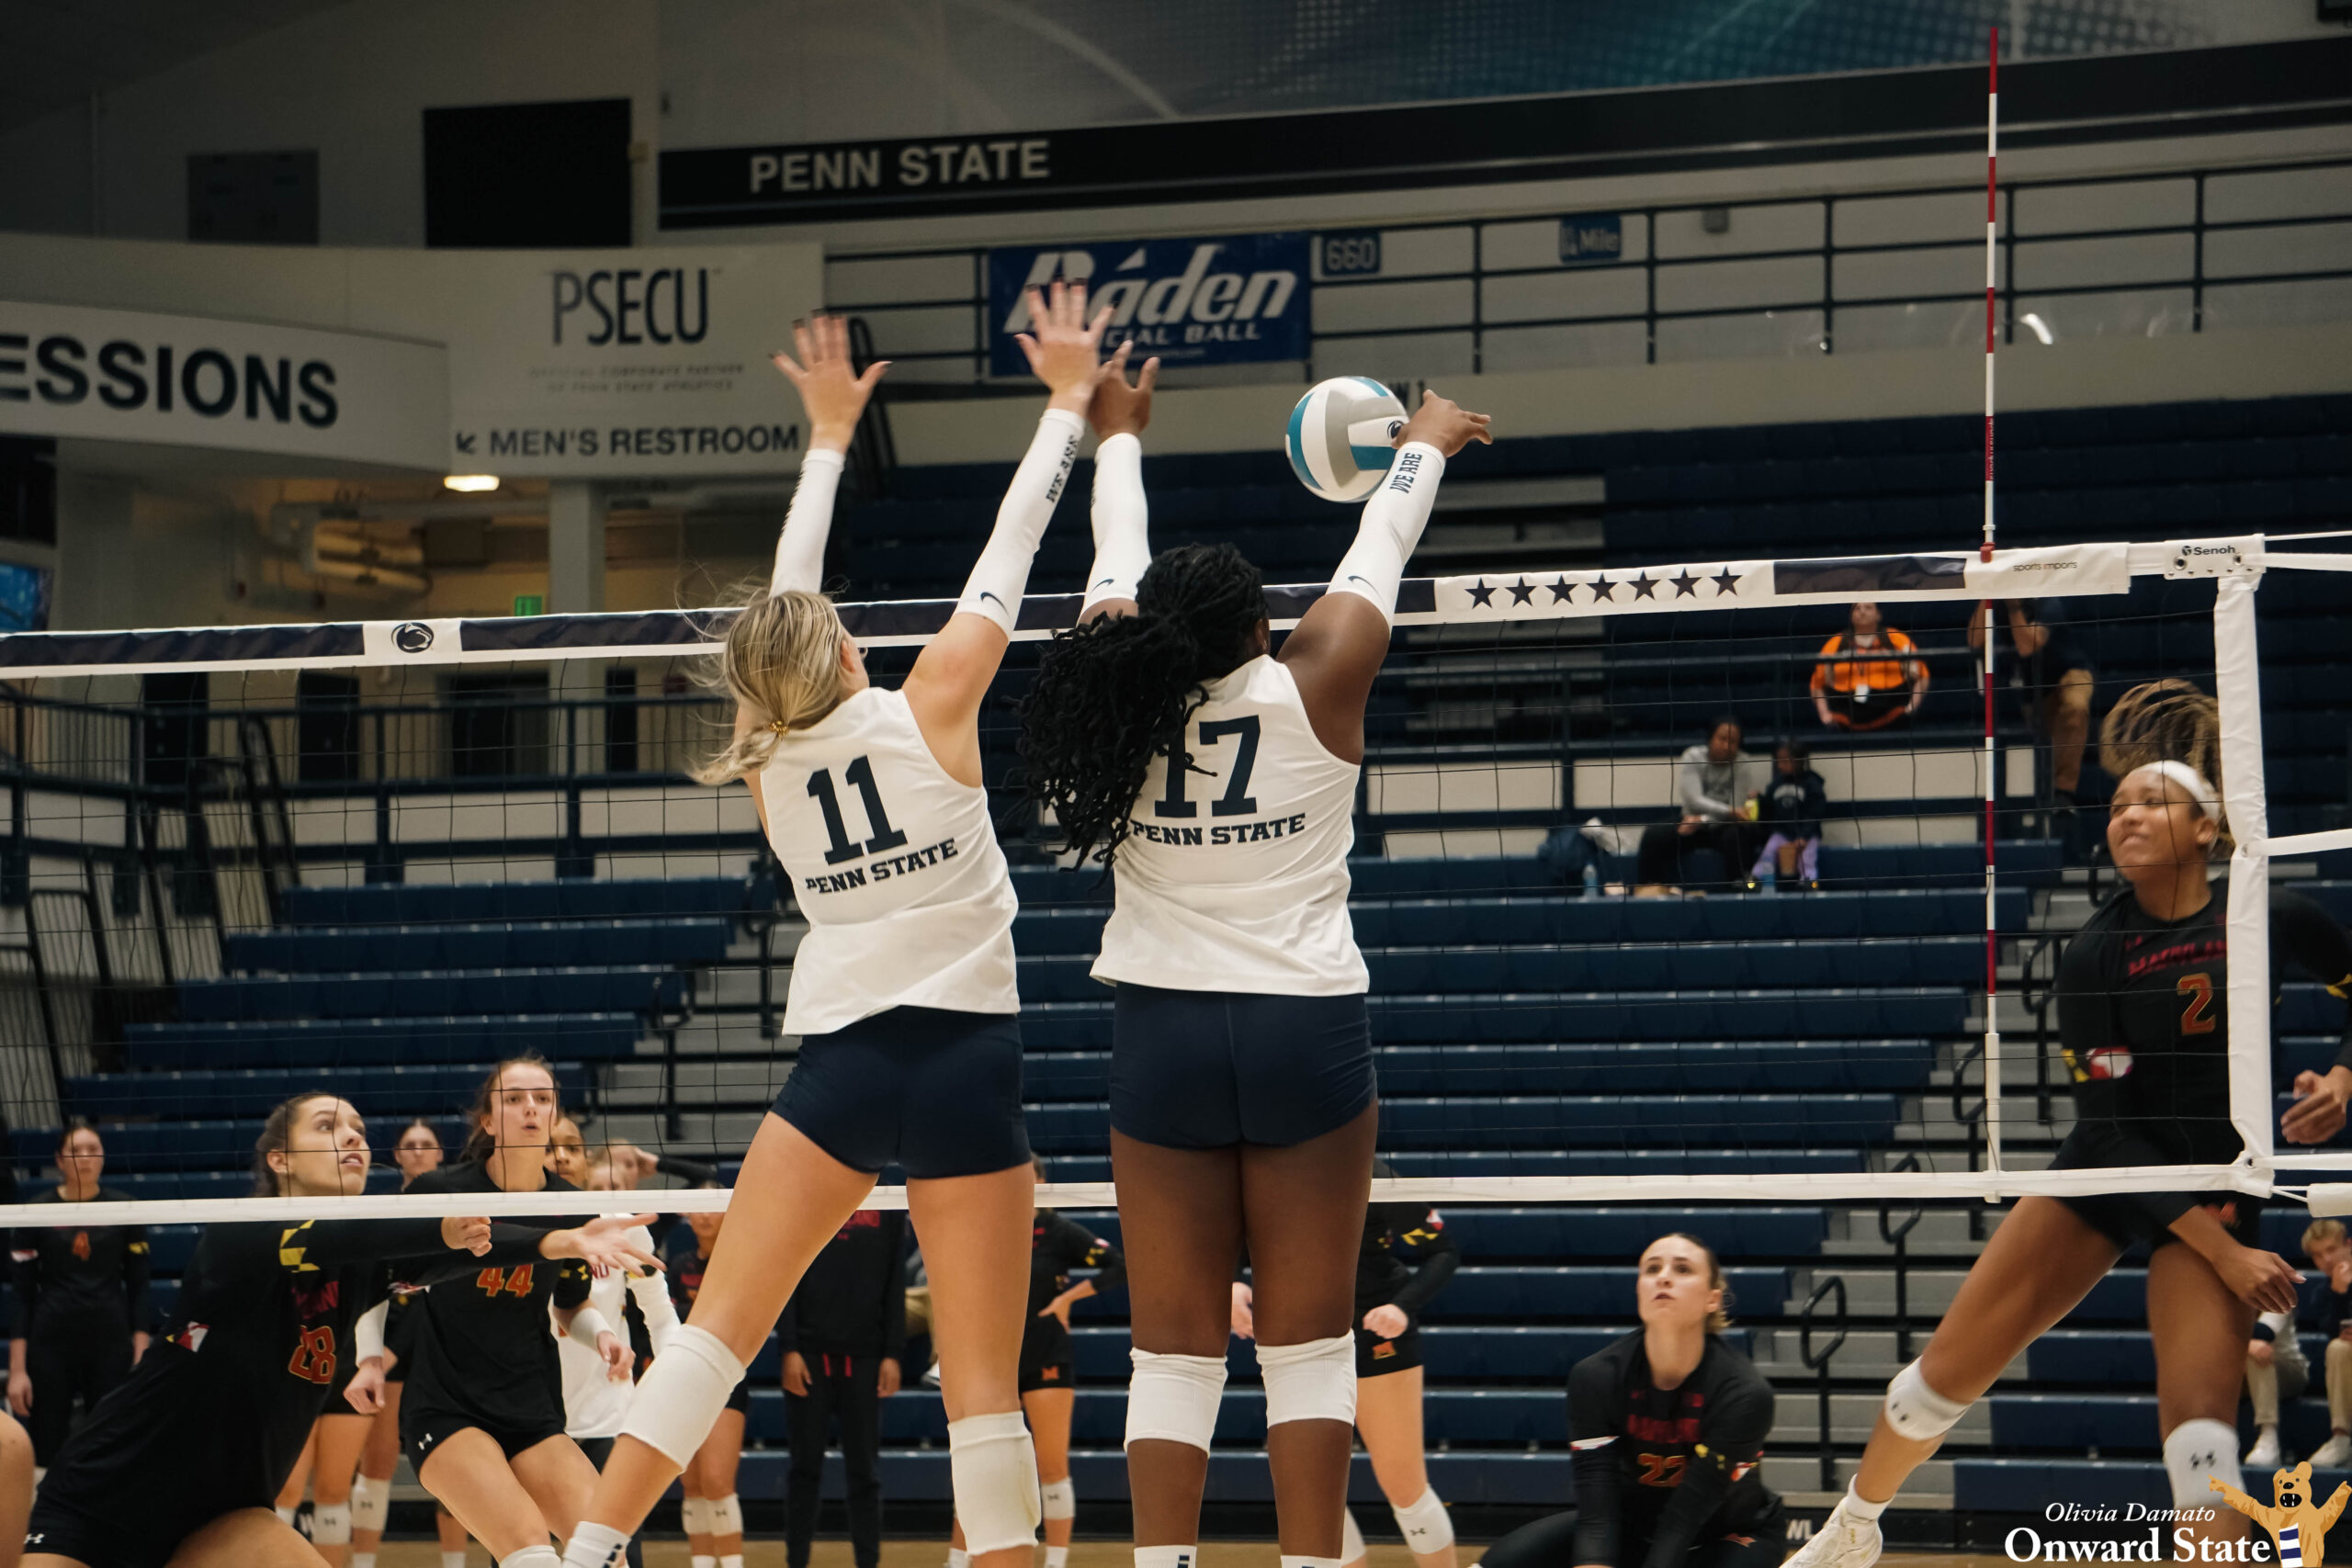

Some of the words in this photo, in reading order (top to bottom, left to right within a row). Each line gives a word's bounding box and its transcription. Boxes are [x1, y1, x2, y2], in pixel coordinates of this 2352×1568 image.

[750, 149, 879, 193] PENN
[899, 140, 1050, 185] STATE
[1327, 237, 1375, 270] 660
[550, 268, 708, 345] PSECU
[1185, 322, 1261, 344] BALL
[490, 429, 597, 457] MEN'S
[610, 424, 799, 457] RESTROOM
[1398, 452, 1423, 474] ARE
[1389, 474, 1414, 493] WE
[2013, 563, 2042, 572] sports
[2193, 546, 2235, 556] Senoh
[1154, 715, 1261, 818] 17
[807, 755, 908, 865] 11
[1130, 819, 1202, 845] PENN
[1211, 812, 1306, 845] STATE
[805, 867, 866, 894] PENN
[870, 838, 958, 881] STATE
[2177, 972, 2216, 1036] 2
[476, 1264, 534, 1297] 44
[288, 1325, 336, 1384] 28
